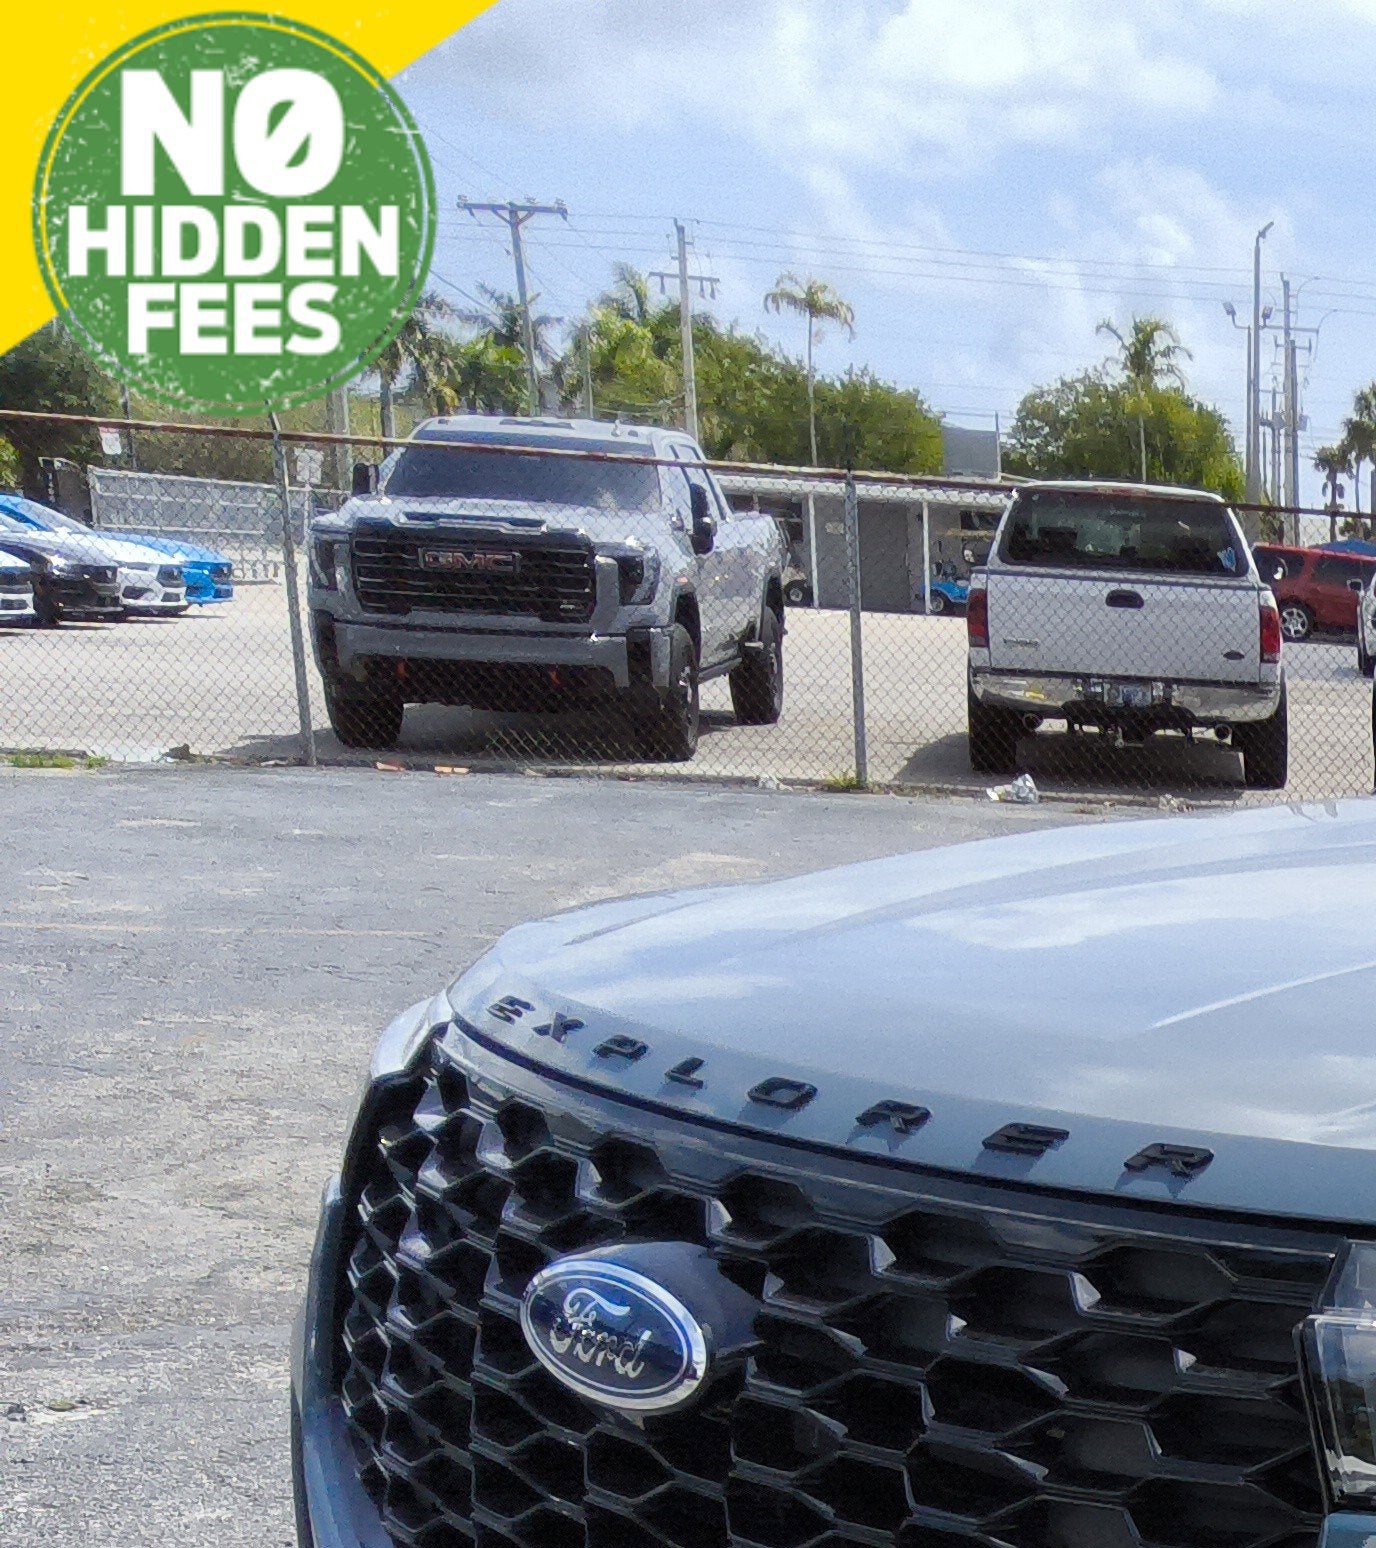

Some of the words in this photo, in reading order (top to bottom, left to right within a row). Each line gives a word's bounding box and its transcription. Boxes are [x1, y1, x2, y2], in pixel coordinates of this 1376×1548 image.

[424, 551, 514, 572] GMC
[488, 995, 1215, 1176] EXPLORER
[550, 1287, 652, 1379] Ford
